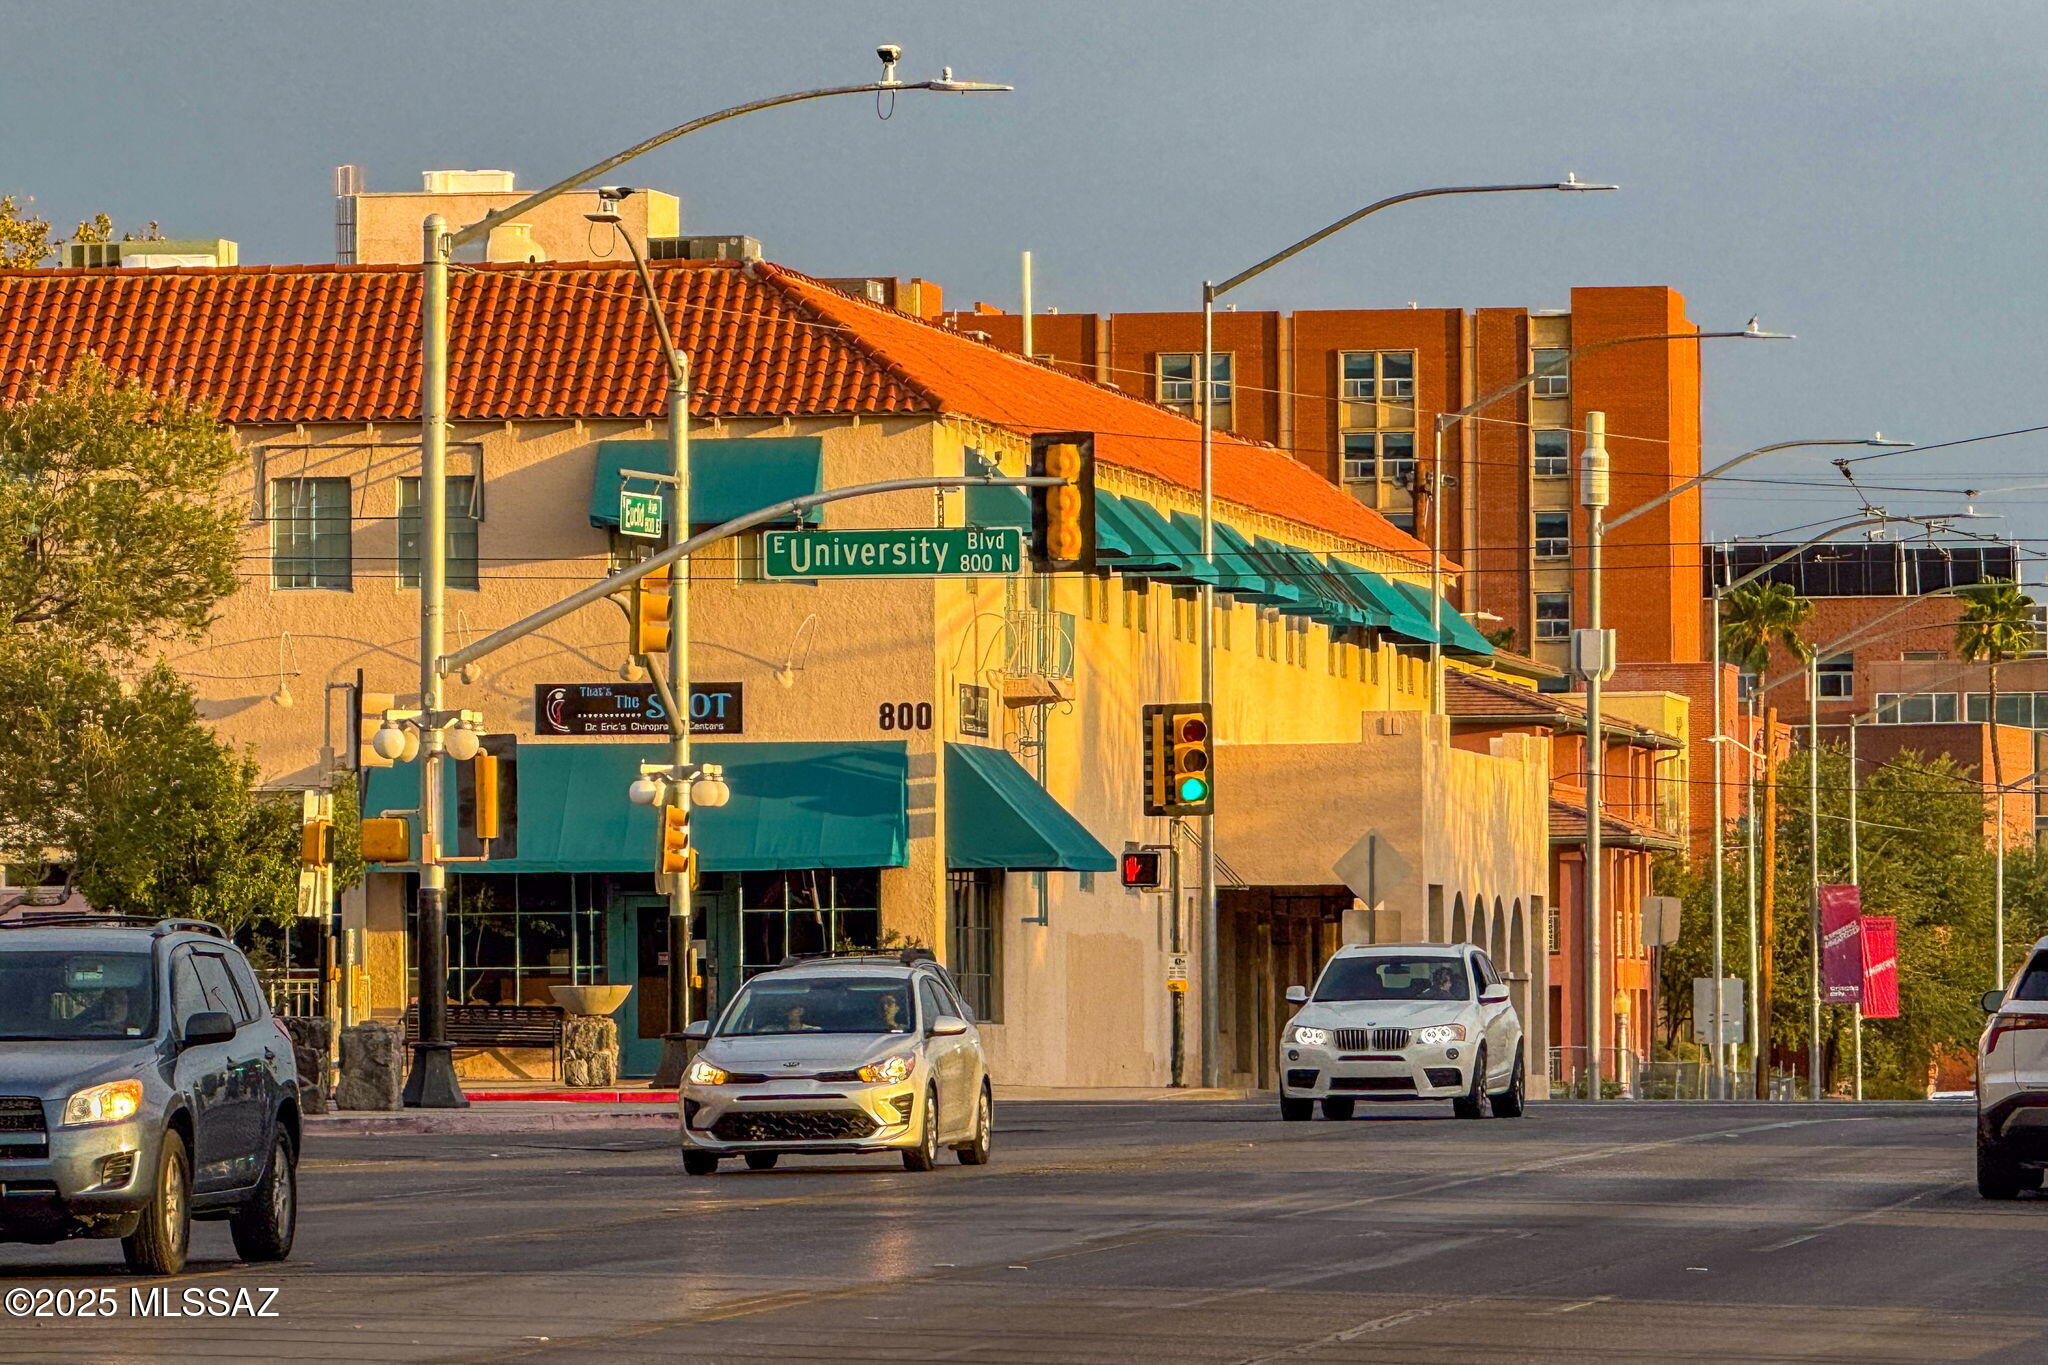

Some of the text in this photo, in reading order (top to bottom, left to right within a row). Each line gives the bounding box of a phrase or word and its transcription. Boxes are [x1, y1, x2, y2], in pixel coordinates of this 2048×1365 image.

[773, 532, 1005, 573] E University Blvd
[960, 553, 1013, 572] 800 N
[580, 686, 612, 697] That's
[614, 691, 732, 718] The SOT
[879, 702, 932, 730] 800
